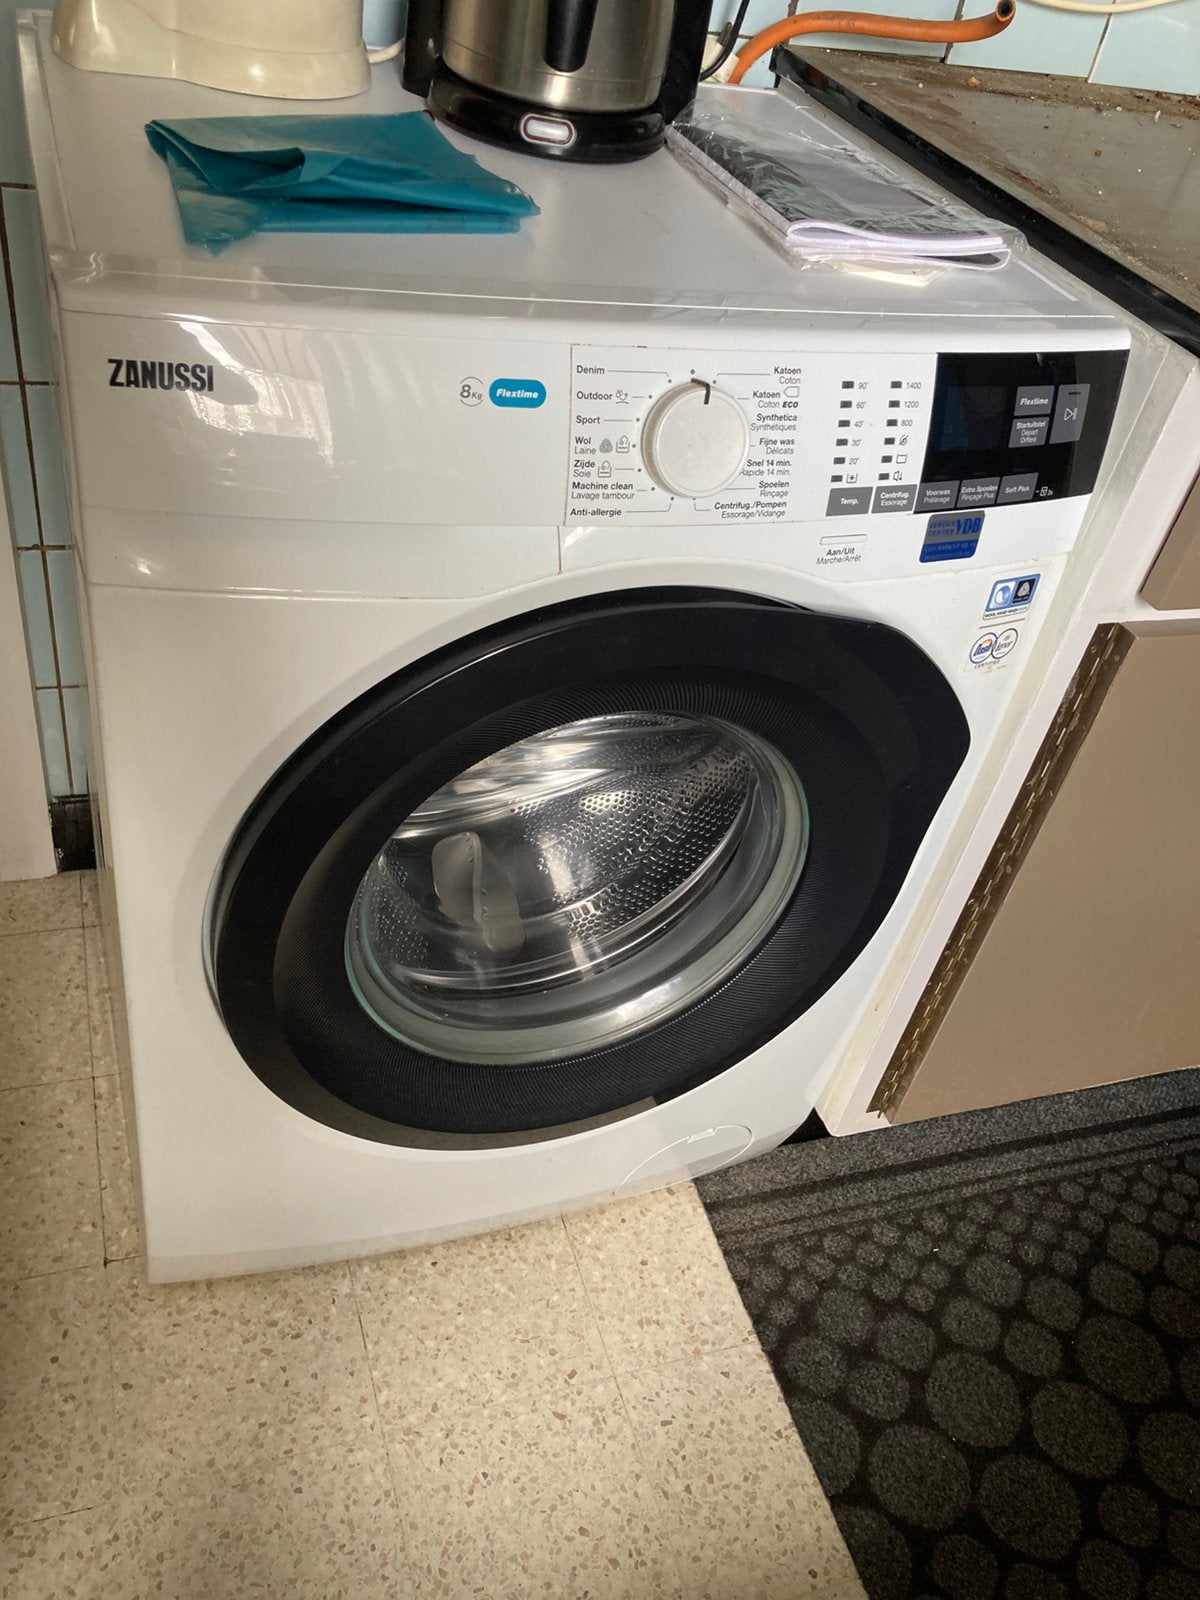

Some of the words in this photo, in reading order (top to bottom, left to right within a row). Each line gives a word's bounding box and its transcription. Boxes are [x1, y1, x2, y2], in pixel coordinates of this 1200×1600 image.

[576, 365, 605, 374] Denim
[774, 366, 801, 375] Katoen
[107, 358, 213, 392] ZANUSSI
[779, 376, 800, 384] Coton
[496, 388, 539, 398] Flextime
[576, 391, 612, 400] Outdoor
[753, 390, 780, 398] Katoen
[758, 400, 779, 408] Coton
[576, 415, 600, 425] Sport
[757, 413, 797, 422] Synthetica
[751, 423, 796, 432] Synthétiques
[575, 436, 591, 445] Wol
[759, 438, 778, 446] Fijne
[575, 446, 596, 455] Laine
[766, 447, 794, 455] Délicats
[574, 460, 595, 469] Zijde
[747, 459, 764, 467] Snel
[766, 459, 774, 467] 14
[776, 459, 792, 467] min.
[573, 469, 591, 477] Soie
[572, 482, 608, 490] Machine
[611, 482, 634, 490] clean
[759, 481, 789, 489] Spoelen
[760, 490, 788, 498] Rinçage
[961, 486, 976, 494] Extra
[571, 492, 600, 501] Lavage
[602, 491, 635, 500] tambour
[881, 491, 910, 499] Centrifug.
[714, 501, 787, 510] Centrifug./Pompen
[881, 499, 907, 507] Essorage
[570, 508, 622, 518] Anti-allergie
[721, 510, 786, 519] Essorage/Vidange
[956, 517, 981, 535] VDB
[928, 529, 954, 537] CENTER
[826, 547, 855, 556] Aan/Uit
[816, 554, 861, 565] Marche/Arrêt
